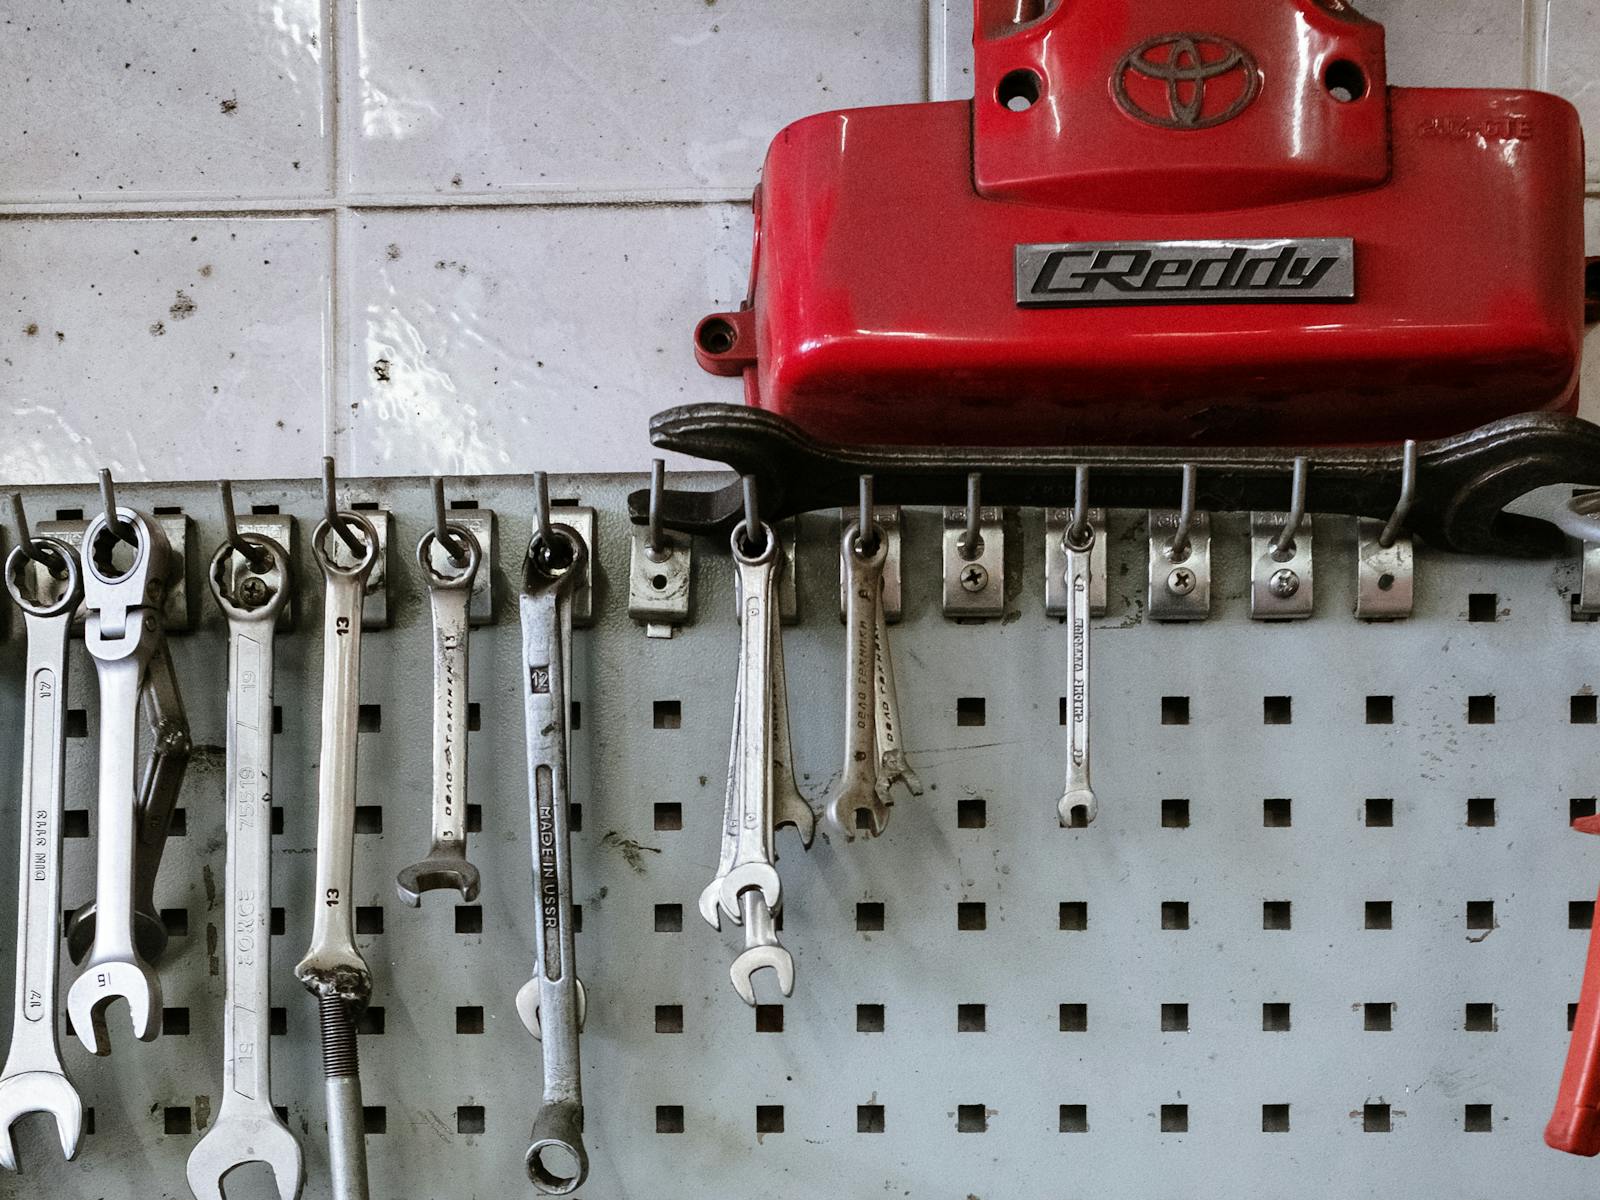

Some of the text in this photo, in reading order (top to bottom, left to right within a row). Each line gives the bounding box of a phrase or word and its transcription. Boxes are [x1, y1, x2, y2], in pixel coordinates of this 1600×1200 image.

[1031, 247, 1339, 293] GReddy
[336, 616, 349, 636] 13
[444, 635, 457, 652] 13
[242, 670, 257, 694] 19
[531, 670, 550, 688] 12
[1073, 618, 1084, 723] CHROME VANADIUM
[39, 681, 52, 699] 17
[238, 766, 257, 831] 75519
[33, 809, 48, 882] DIN 3113
[538, 806, 559, 929] MADE IN USSR
[325, 887, 340, 908] 13
[237, 888, 256, 968] FORCE
[29, 989, 43, 1009] 17
